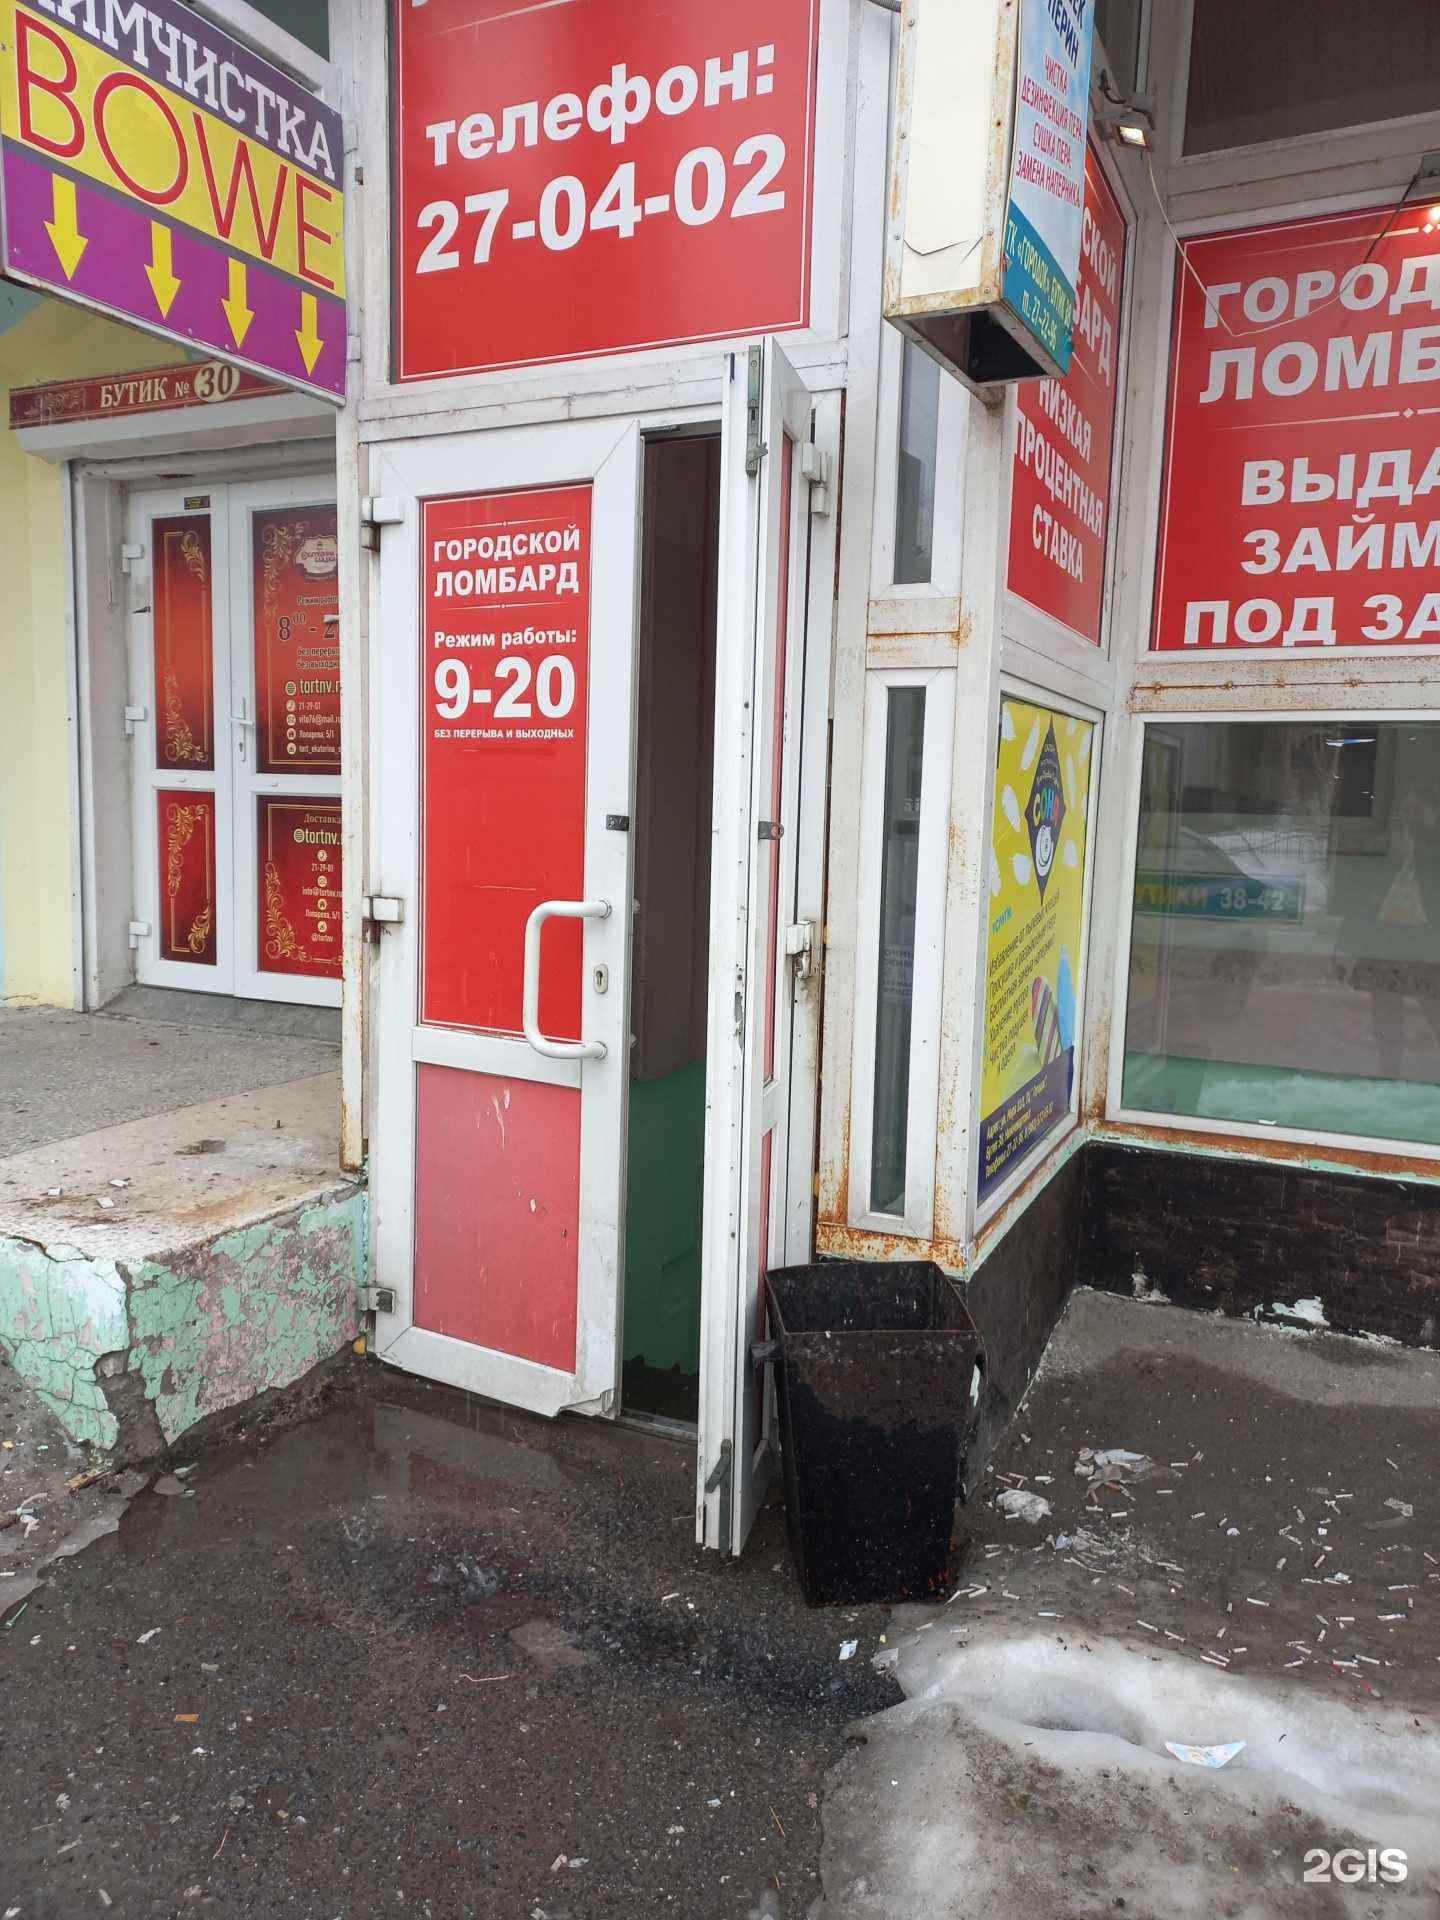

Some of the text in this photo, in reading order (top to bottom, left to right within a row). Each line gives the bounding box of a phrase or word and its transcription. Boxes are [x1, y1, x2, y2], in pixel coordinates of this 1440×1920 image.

[37, 0, 335, 181] ИМЧИСТКА
[426, 44, 774, 166] телефон:
[1045, 54, 1068, 96] ЧИСТКА
[15, 8, 335, 290] BOWE
[416, 134, 785, 274] 27-04-02
[1203, 254, 1440, 329] ГОРОД
[100, 377, 168, 408] БУТИК
[200, 365, 233, 398] 30
[1039, 378, 1092, 463] НИЗКАЯ
[1015, 407, 1103, 538] ПРОЦЕНТНАЯ
[433, 524, 580, 562] ГОРОДСКОЙ
[1033, 503, 1083, 583] СТАВКА
[1241, 513, 1440, 575] ЗАЙМ
[434, 562, 580, 598] ЛОМБАРД
[434, 627, 577, 649] Режим работы:
[1184, 597, 1336, 646] ПОД
[434, 655, 576, 719] 9-20
[434, 728, 574, 740] БЕЗ ПЕРЕРЫВА И ВЫХОДНЫХ
